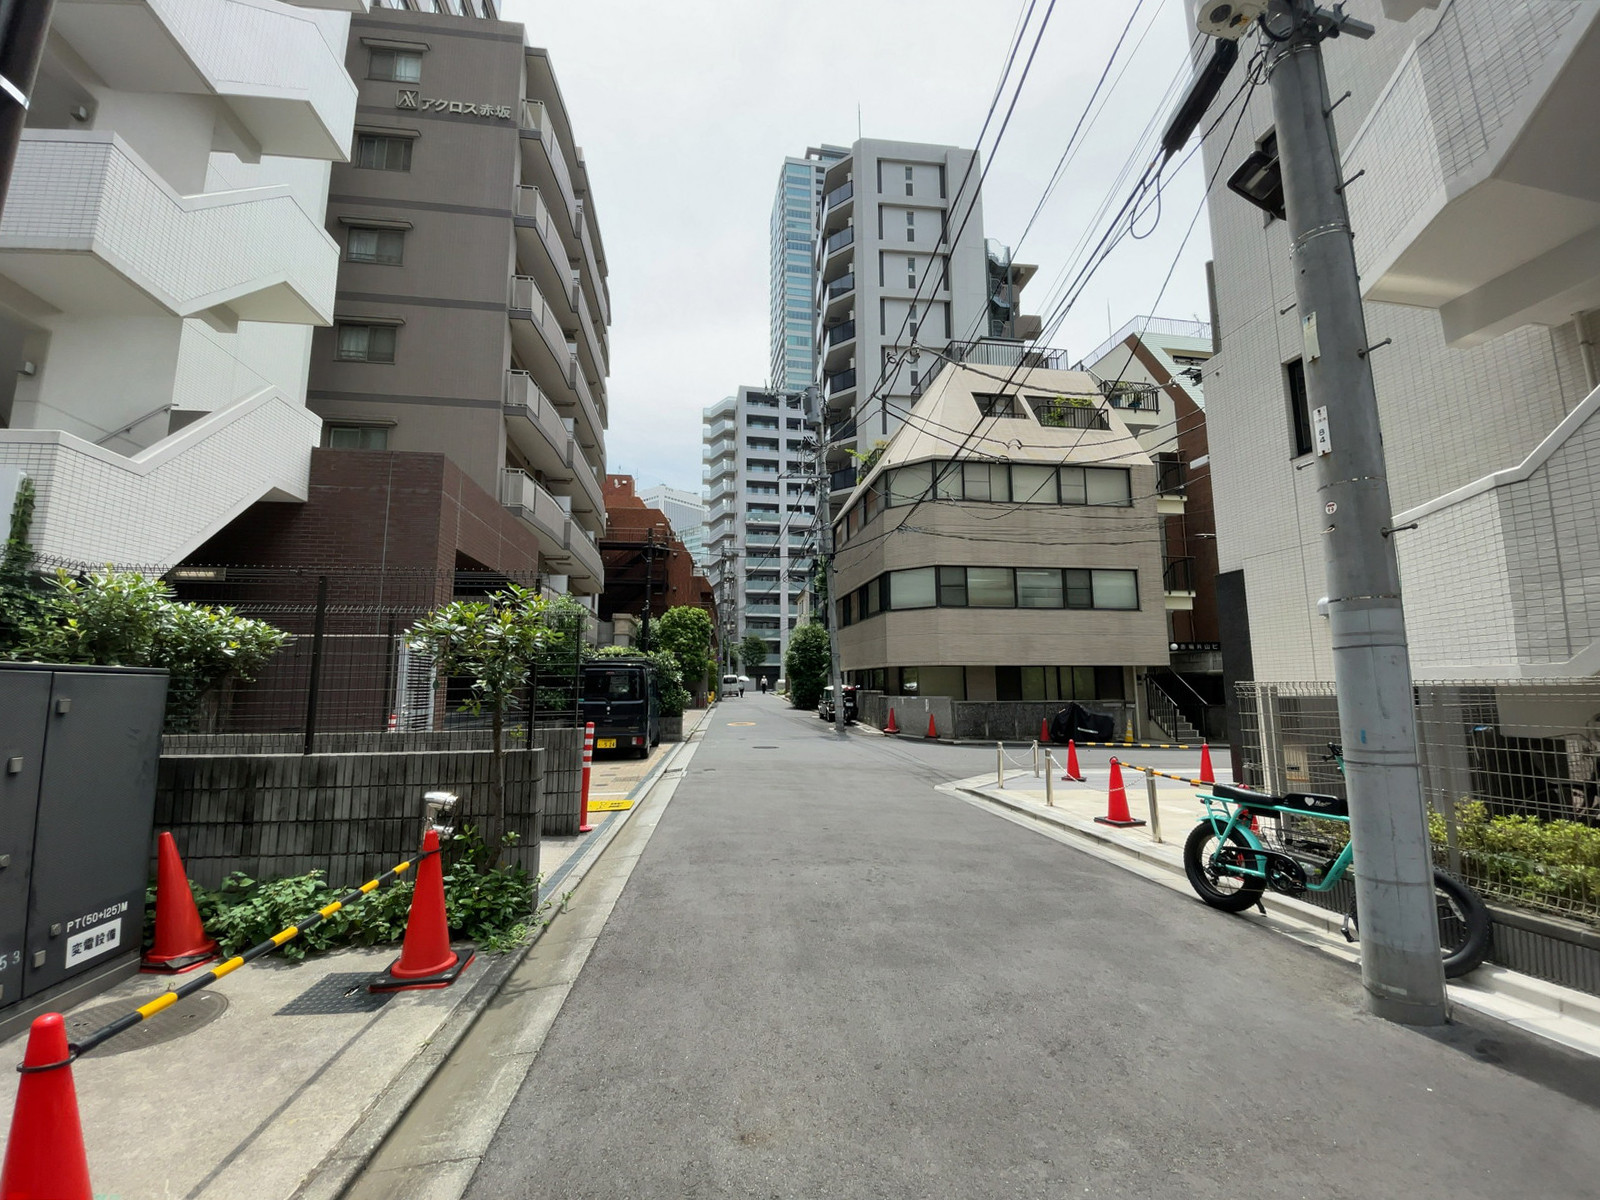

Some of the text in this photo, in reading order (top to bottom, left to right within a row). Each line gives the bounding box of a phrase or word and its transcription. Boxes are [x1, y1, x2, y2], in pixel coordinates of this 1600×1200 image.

[422, 98, 511, 118] アクロス赤坂
[71, 928, 116, 957] 変電設備
